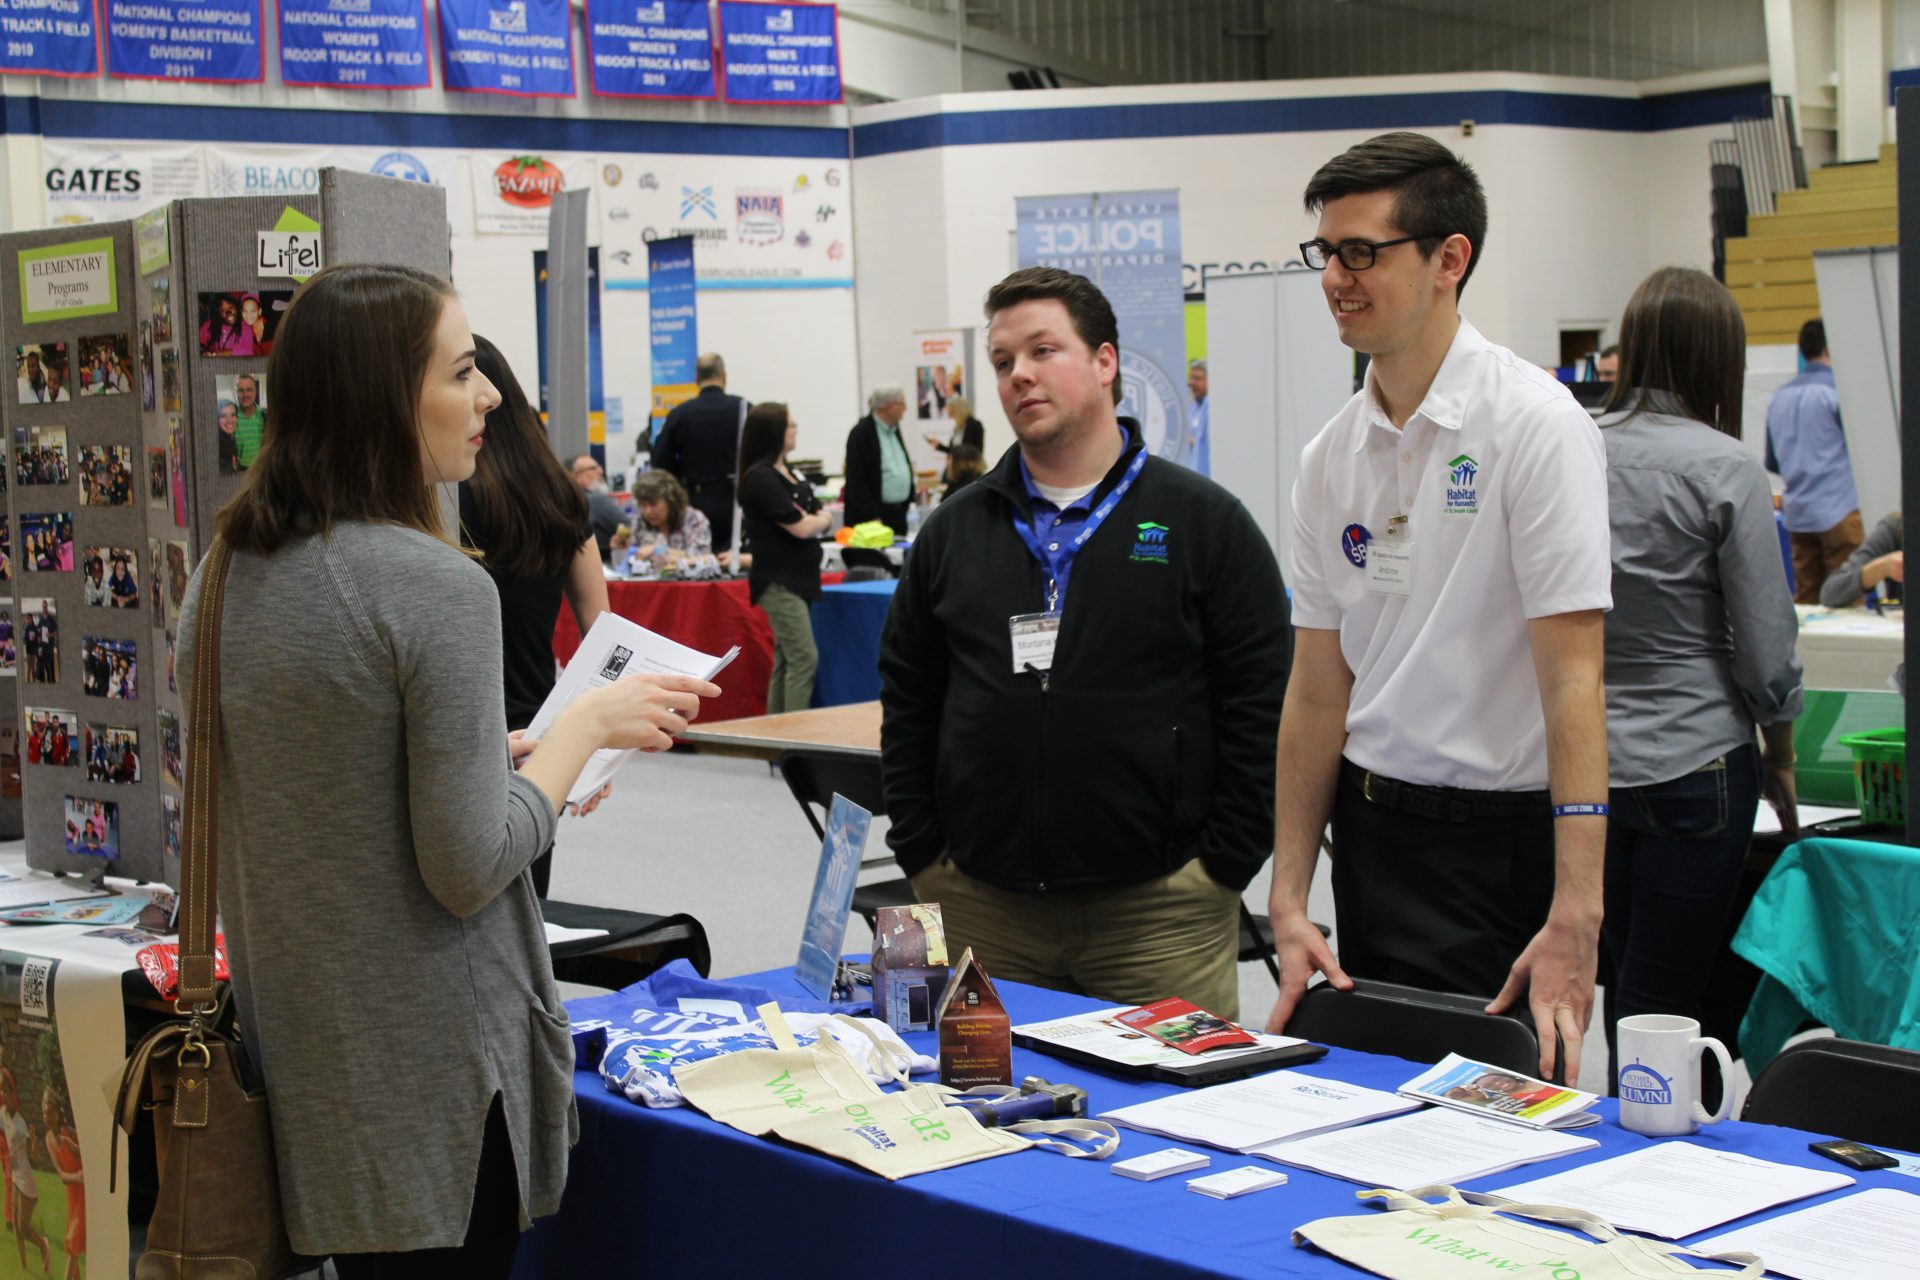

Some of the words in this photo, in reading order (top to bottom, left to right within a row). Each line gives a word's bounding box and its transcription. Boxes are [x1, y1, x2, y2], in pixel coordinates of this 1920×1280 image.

[113, 4, 174, 21] NATIONAL
[178, 8, 251, 25] CHAMPIONS
[284, 12, 343, 26] NATIONAL
[345, 14, 416, 29] CHAMPIONS
[2, 18, 45, 32] TRACK
[46, 20, 54, 34] &
[56, 21, 90, 36] FIELD
[594, 24, 646, 38] NATIONAL
[647, 27, 708, 40] CHAMPIONS
[170, 27, 254, 44] BASKETBALL
[322, 31, 379, 47] WOMEN'S
[457, 28, 503, 46] NATIONAL
[504, 33, 565, 49] CHAMPIONS
[727, 33, 776, 47] NATIONAL
[776, 35, 833, 47] CHAMPIONS
[150, 45, 204, 60] DIVISION
[628, 41, 677, 55] WOMEN'S
[766, 49, 797, 61] MEN'S
[283, 48, 327, 62] INDOOR
[330, 50, 372, 64] TRACK
[374, 52, 383, 64] &
[387, 52, 422, 65] FIELD
[497, 53, 529, 68] TRACK
[595, 55, 636, 68] INDOOR
[637, 57, 671, 70] TRACK
[682, 59, 711, 71] FIELD
[166, 64, 194, 77] 2011
[338, 69, 366, 81] 2011
[727, 64, 766, 75] INDOOR
[767, 64, 800, 76] TRACK
[809, 65, 836, 76] FIELD
[46, 168, 141, 192] GATES
[244, 166, 318, 190] BEACO
[737, 196, 784, 216] NAIA
[32, 256, 102, 277] ELEMENTARY
[48, 281, 89, 297] Programs
[1447, 489, 1476, 500] Habitat
[1134, 542, 1167, 552] Habitat
[1018, 639, 1051, 649] Montana
[1624, 1080, 1654, 1088] COLLEGE
[1294, 1085, 1348, 1100] ReStore
[1405, 1226, 1491, 1260] What
